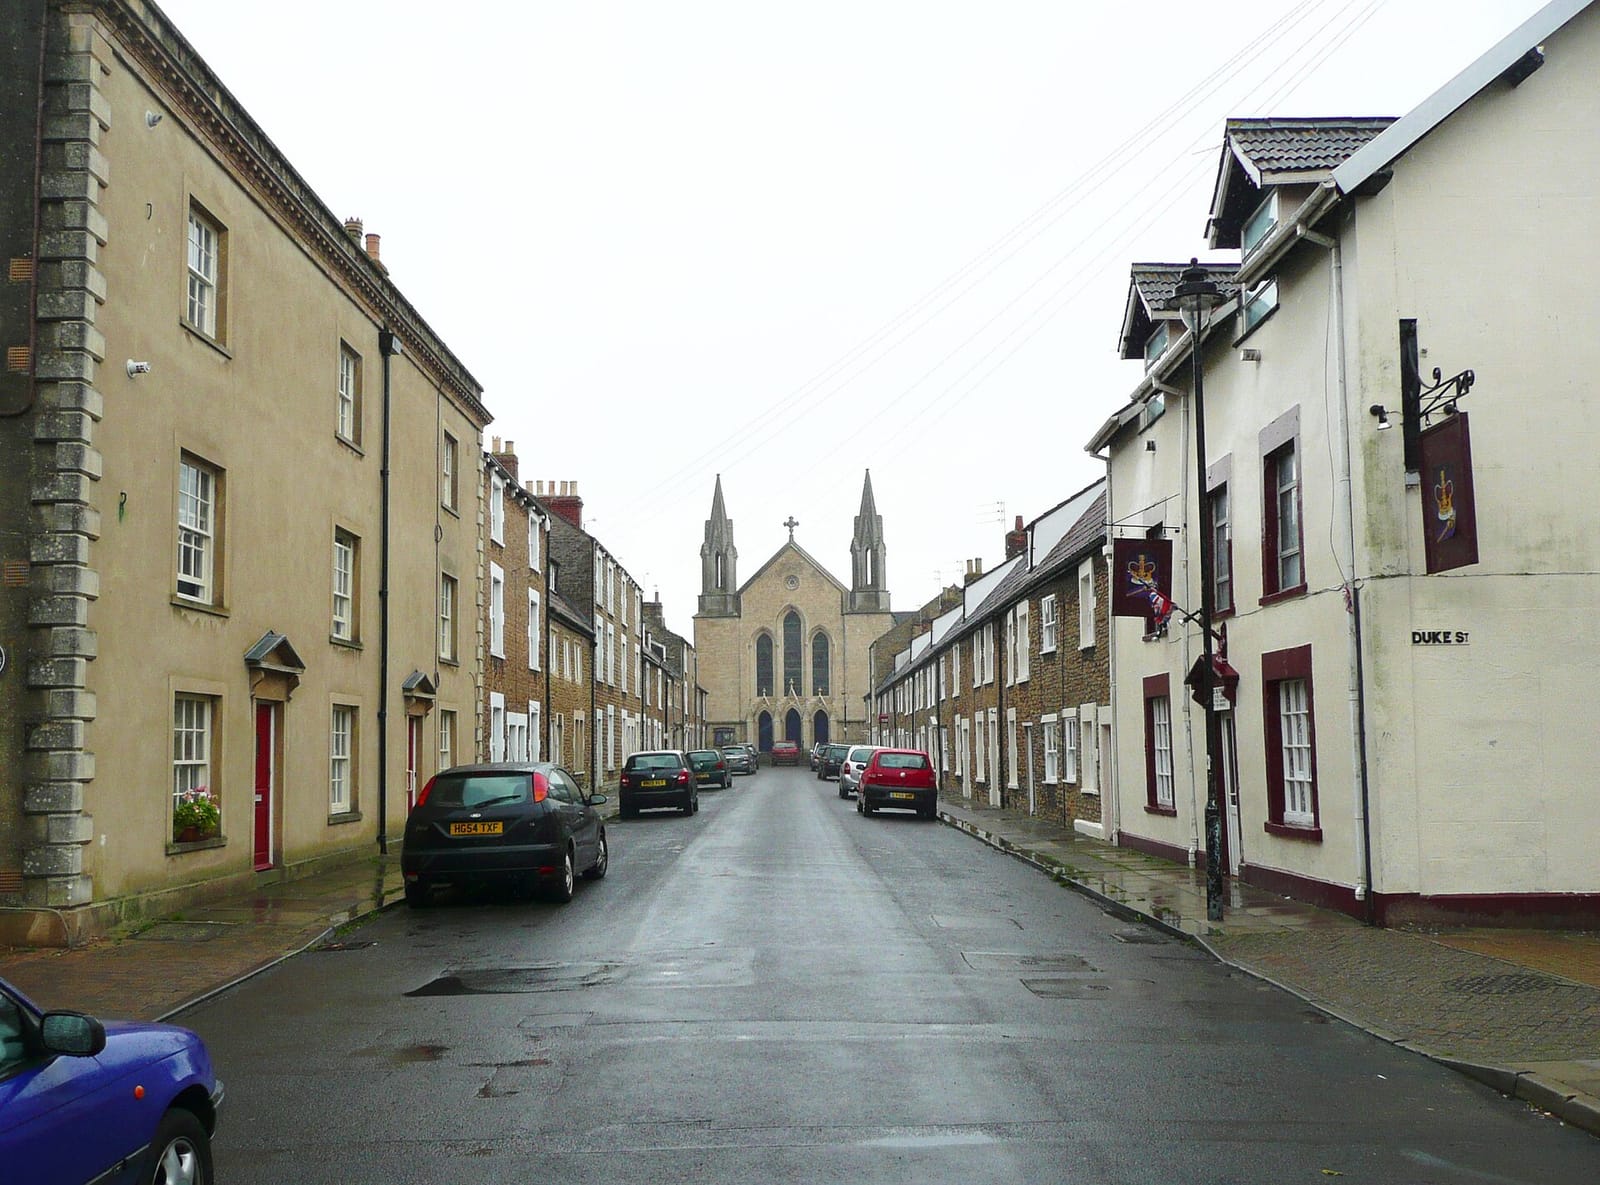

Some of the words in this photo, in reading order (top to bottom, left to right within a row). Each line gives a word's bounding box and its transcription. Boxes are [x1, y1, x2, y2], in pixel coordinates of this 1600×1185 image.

[1411, 631, 1452, 643] DUKE
[454, 823, 478, 833] HG54
[480, 823, 499, 832] TXF
